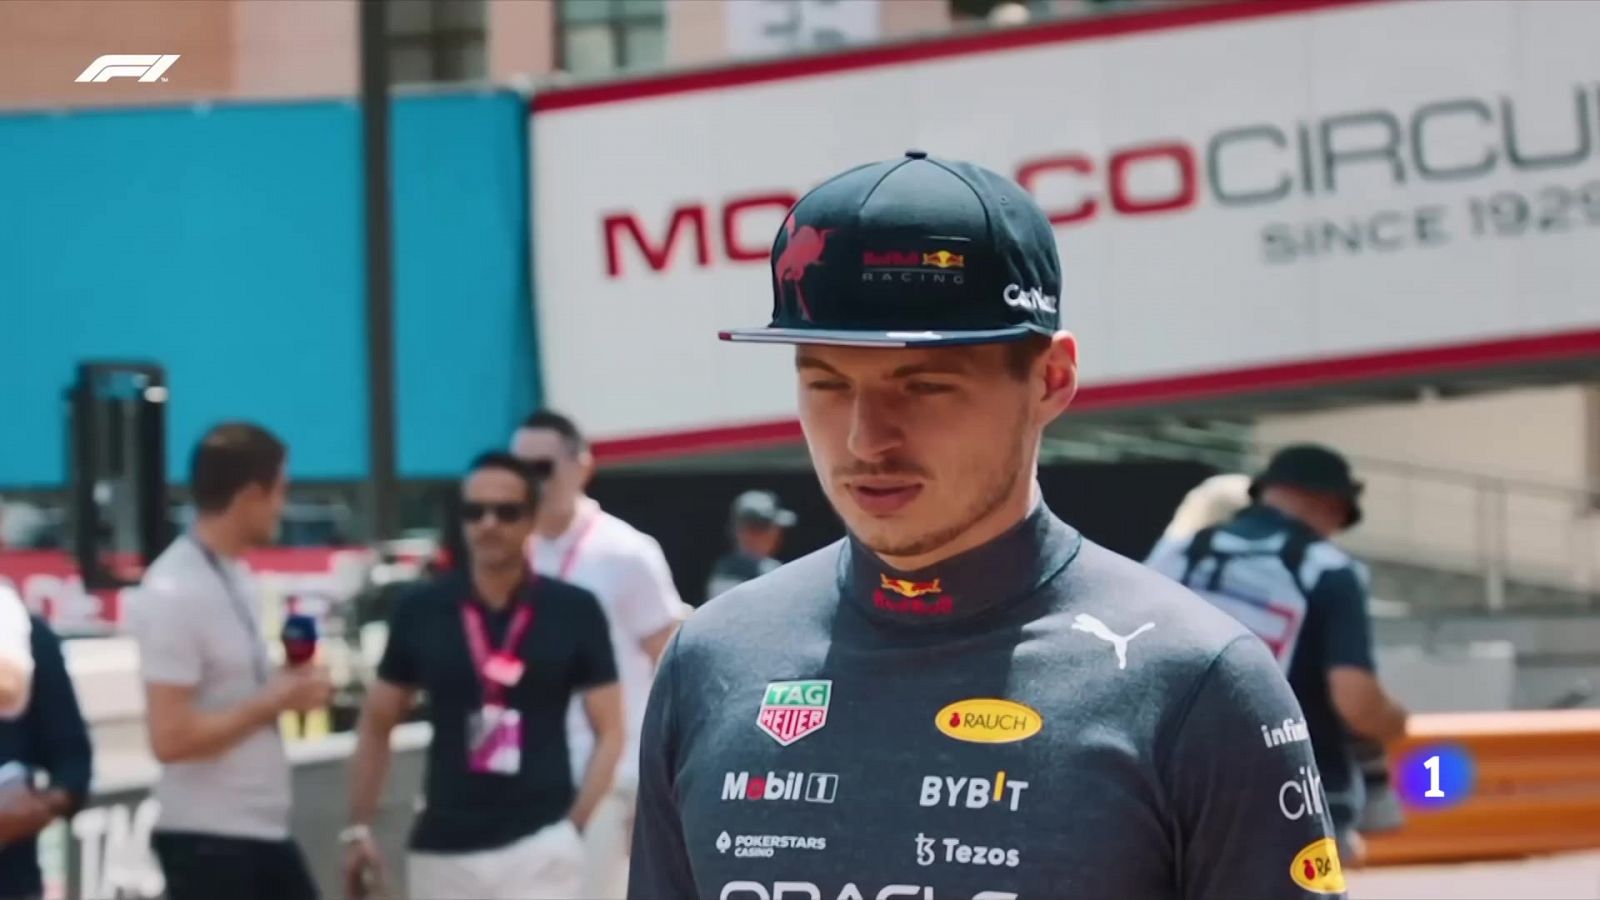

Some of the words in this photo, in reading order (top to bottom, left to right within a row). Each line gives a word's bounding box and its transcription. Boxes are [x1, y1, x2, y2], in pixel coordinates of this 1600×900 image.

[1262, 205, 1449, 265] SINCE
[862, 272, 964, 285] RACING
[771, 685, 825, 705] TAG
[761, 709, 823, 742] HEUER
[963, 713, 1028, 732] RAUCH
[721, 771, 804, 801] Mobil
[919, 770, 1029, 811] BYBIT
[734, 847, 775, 858] CASINO
[735, 835, 826, 850] POKERSTARS
[942, 837, 1020, 867] Tezos
